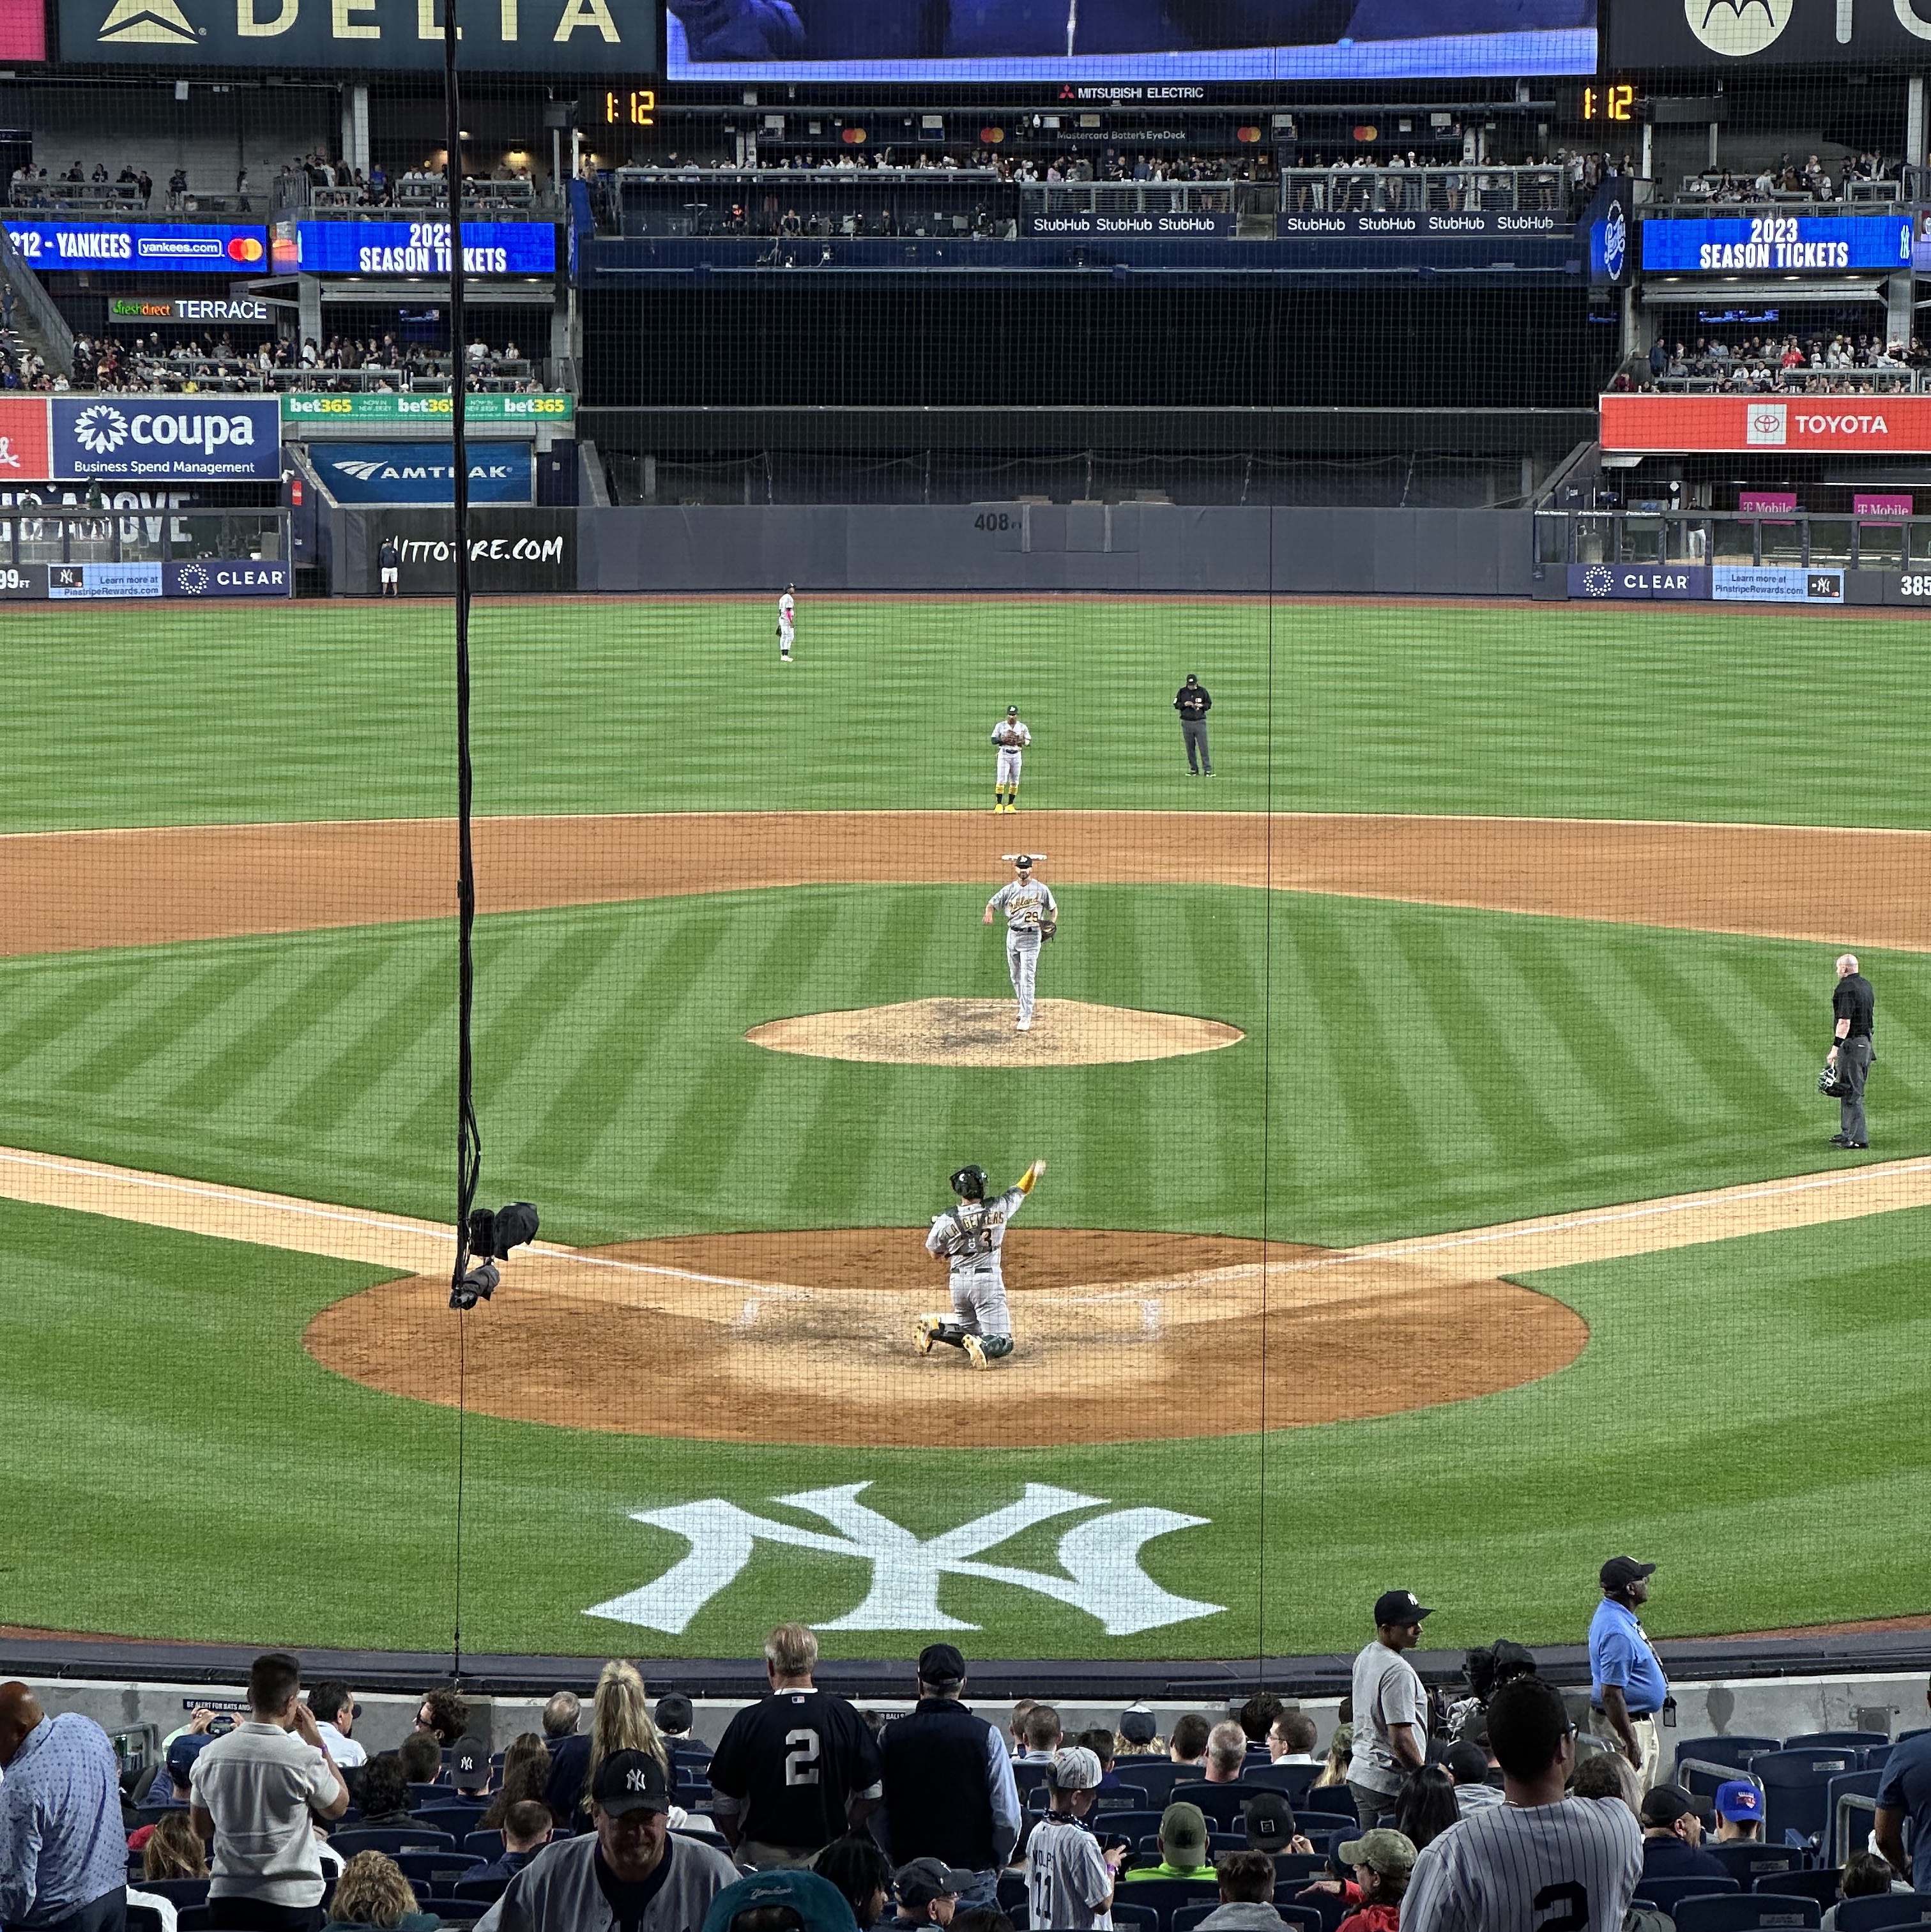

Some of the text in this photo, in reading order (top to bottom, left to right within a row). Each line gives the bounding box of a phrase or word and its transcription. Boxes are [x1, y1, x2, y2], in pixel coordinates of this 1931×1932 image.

[1078, 87, 1204, 98] MITSUBISHI ELECTRIC
[607, 91, 655, 125] 1:12
[1584, 85, 1633, 120] 1:12
[1057, 130, 1109, 139] Mastercard
[1034, 218, 1214, 231] StubHub StubHub StubHub
[1287, 216, 1553, 231] StubHub StubHub StubHub StubHub
[1750, 218, 1797, 243] 2023
[56, 232, 131, 258] YANKEES
[142, 242, 219, 254] yankees.com
[359, 247, 507, 272] SEASON TIKETS
[1700, 242, 1849, 270] SEASON TICKETS
[118, 300, 267, 319] freshdirect TERRACE
[290, 398, 353, 413] bet365
[504, 398, 565, 413] bet365
[1795, 415, 1888, 434] TOYOTA
[131, 414, 254, 455] coupa
[74, 460, 255, 475] Business Spend Management
[974, 513, 1009, 531] 408
[391, 535, 563, 565] ITTORE.COM
[100, 576, 123, 584] Learn
[217, 571, 283, 586] CLEAR
[1624, 574, 1688, 589] CLEAR
[1901, 575, 1931, 596] 385
[1715, 584, 1803, 595] PinstripeRewards.com
[786, 1728, 820, 1786] 2
[627, 1768, 646, 1791] NY
[1032, 1849, 1054, 1869] VOLP
